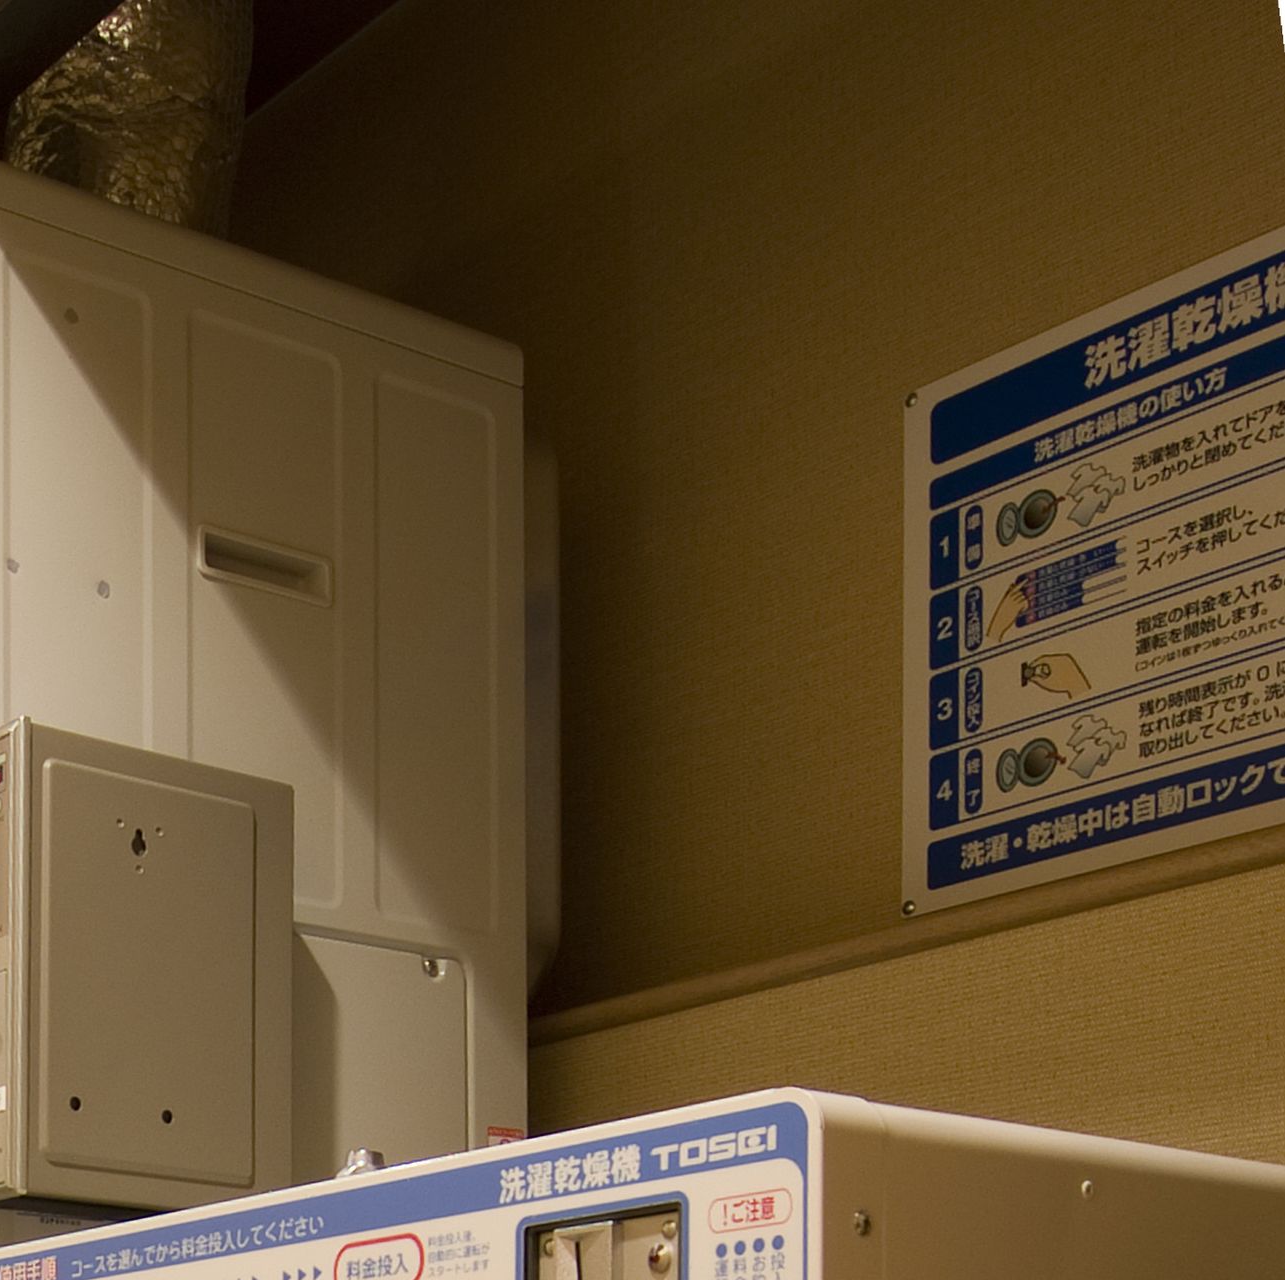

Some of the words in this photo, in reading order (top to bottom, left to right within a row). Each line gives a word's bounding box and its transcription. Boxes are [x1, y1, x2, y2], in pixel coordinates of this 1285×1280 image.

[1034, 367, 1228, 463] 洗濯乾燥機の使い方
[940, 535, 950, 558] 1
[937, 615, 953, 640] 2
[1135, 600, 1268, 656] 運転を開始します。
[937, 697, 953, 721] 3
[936, 779, 954, 802] 4
[499, 1143, 642, 1204] 洗濯乾燥機
[650, 1124, 778, 1171] TOSEI
[70, 1215, 324, 1278] コースを選んでから料金投入してください
[347, 1253, 409, 1280] 料金投入
